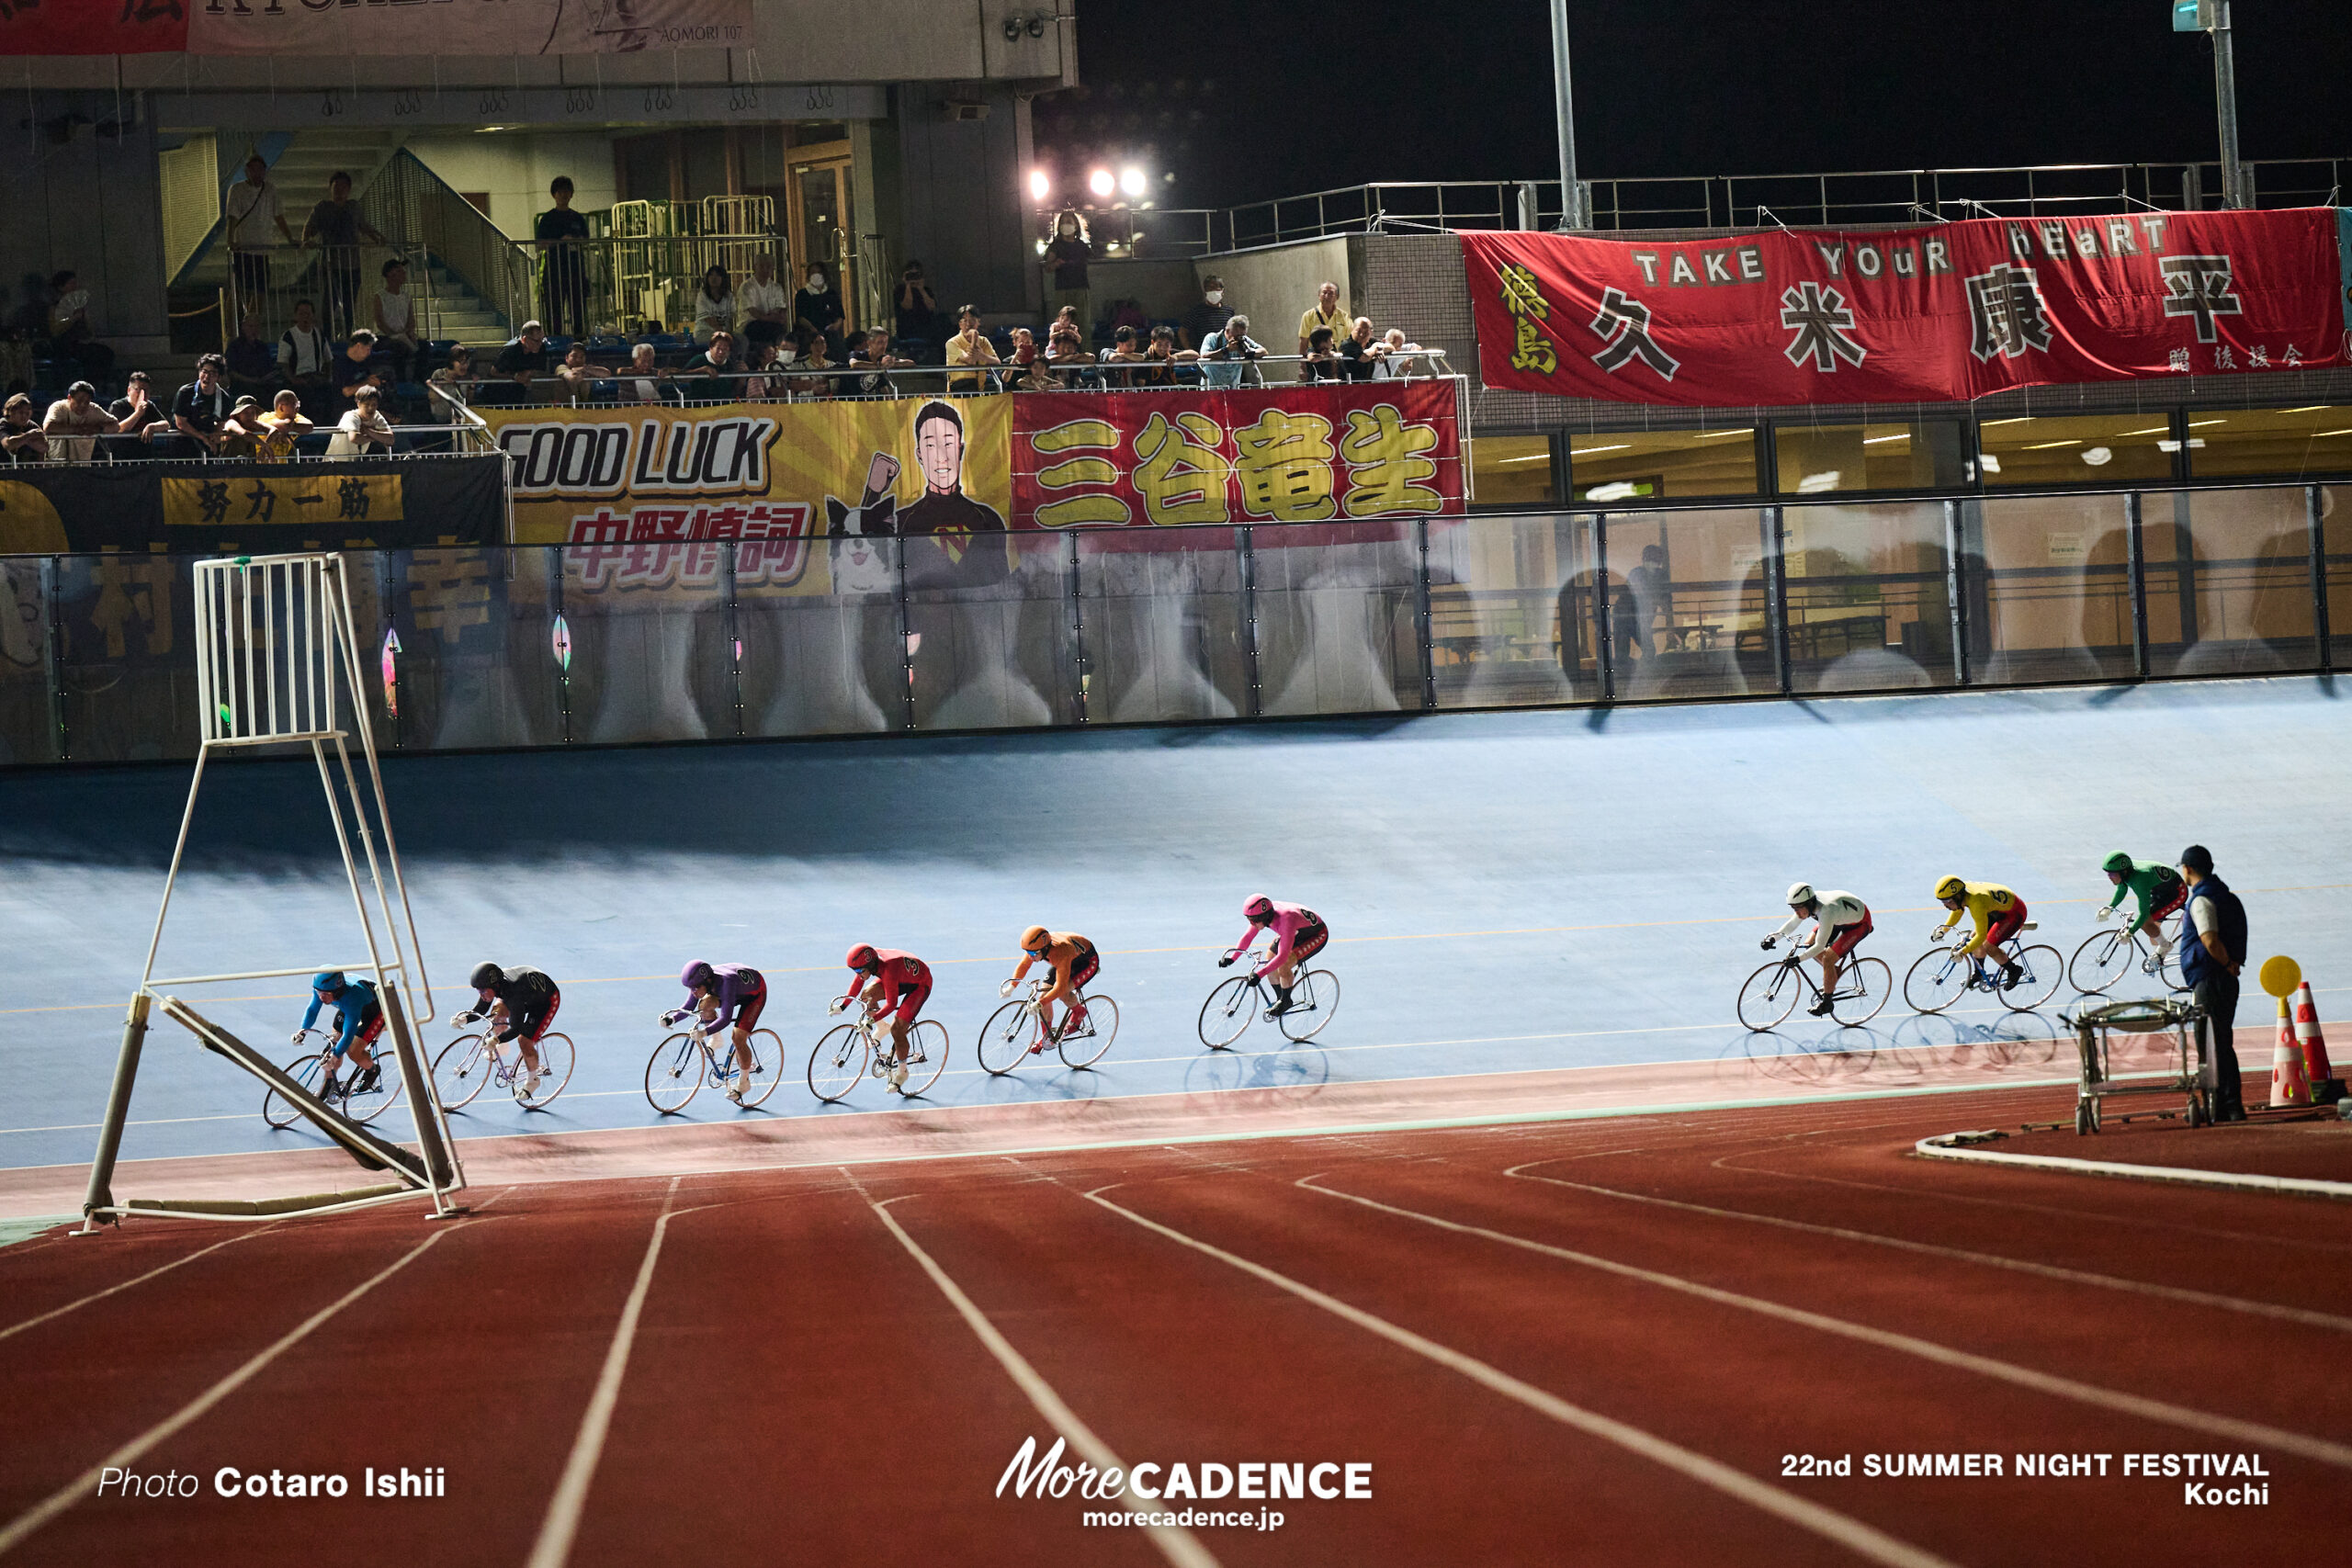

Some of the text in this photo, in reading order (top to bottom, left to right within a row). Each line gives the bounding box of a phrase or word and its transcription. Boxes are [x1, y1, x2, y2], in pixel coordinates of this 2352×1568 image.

[660, 26, 742, 42] AOMORI 107
[1634, 247, 1765, 285] TAKE
[1589, 255, 2243, 382] 久米康平
[498, 417, 775, 491] GOOD LUCK
[1032, 403, 1444, 528] 三谷竜生
[198, 478, 371, 525] 努力一筋
[565, 501, 811, 588] 中野慎詞
[2154, 865, 2171, 882] 6
[1950, 883, 1958, 894] 5
[1990, 889, 2008, 905] 5
[1261, 900, 1267, 912] 8
[1300, 908, 1317, 926] 8
[865, 949, 872, 962] 3
[699, 966, 707, 979] 9
[903, 956, 920, 976] 3
